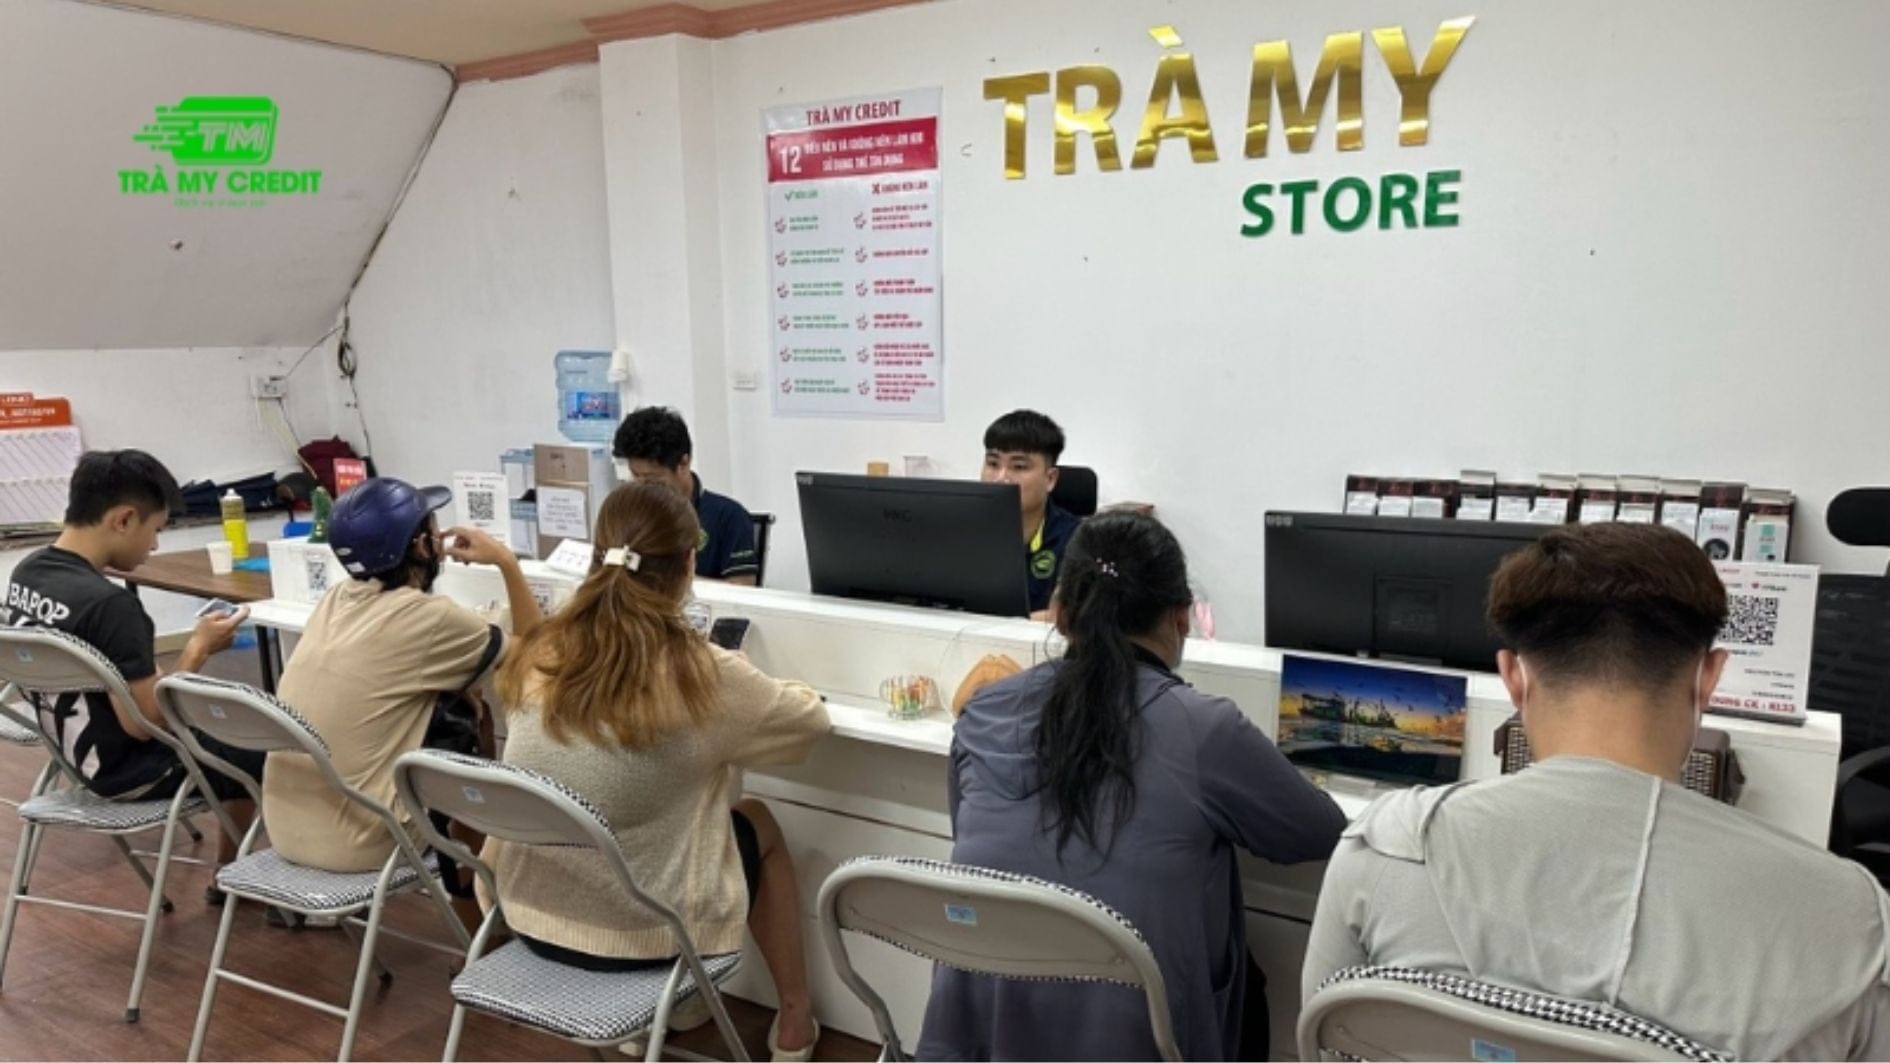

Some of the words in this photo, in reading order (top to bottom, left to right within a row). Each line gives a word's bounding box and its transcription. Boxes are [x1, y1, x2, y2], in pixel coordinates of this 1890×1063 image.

[806, 106, 830, 126] TRÀ
[834, 105, 851, 121] MY
[855, 100, 901, 120] CREDIT
[983, 24, 1219, 180] TRÀ
[1244, 16, 1476, 159] MY
[780, 145, 802, 174] 12
[1240, 170, 1461, 236] STORE
